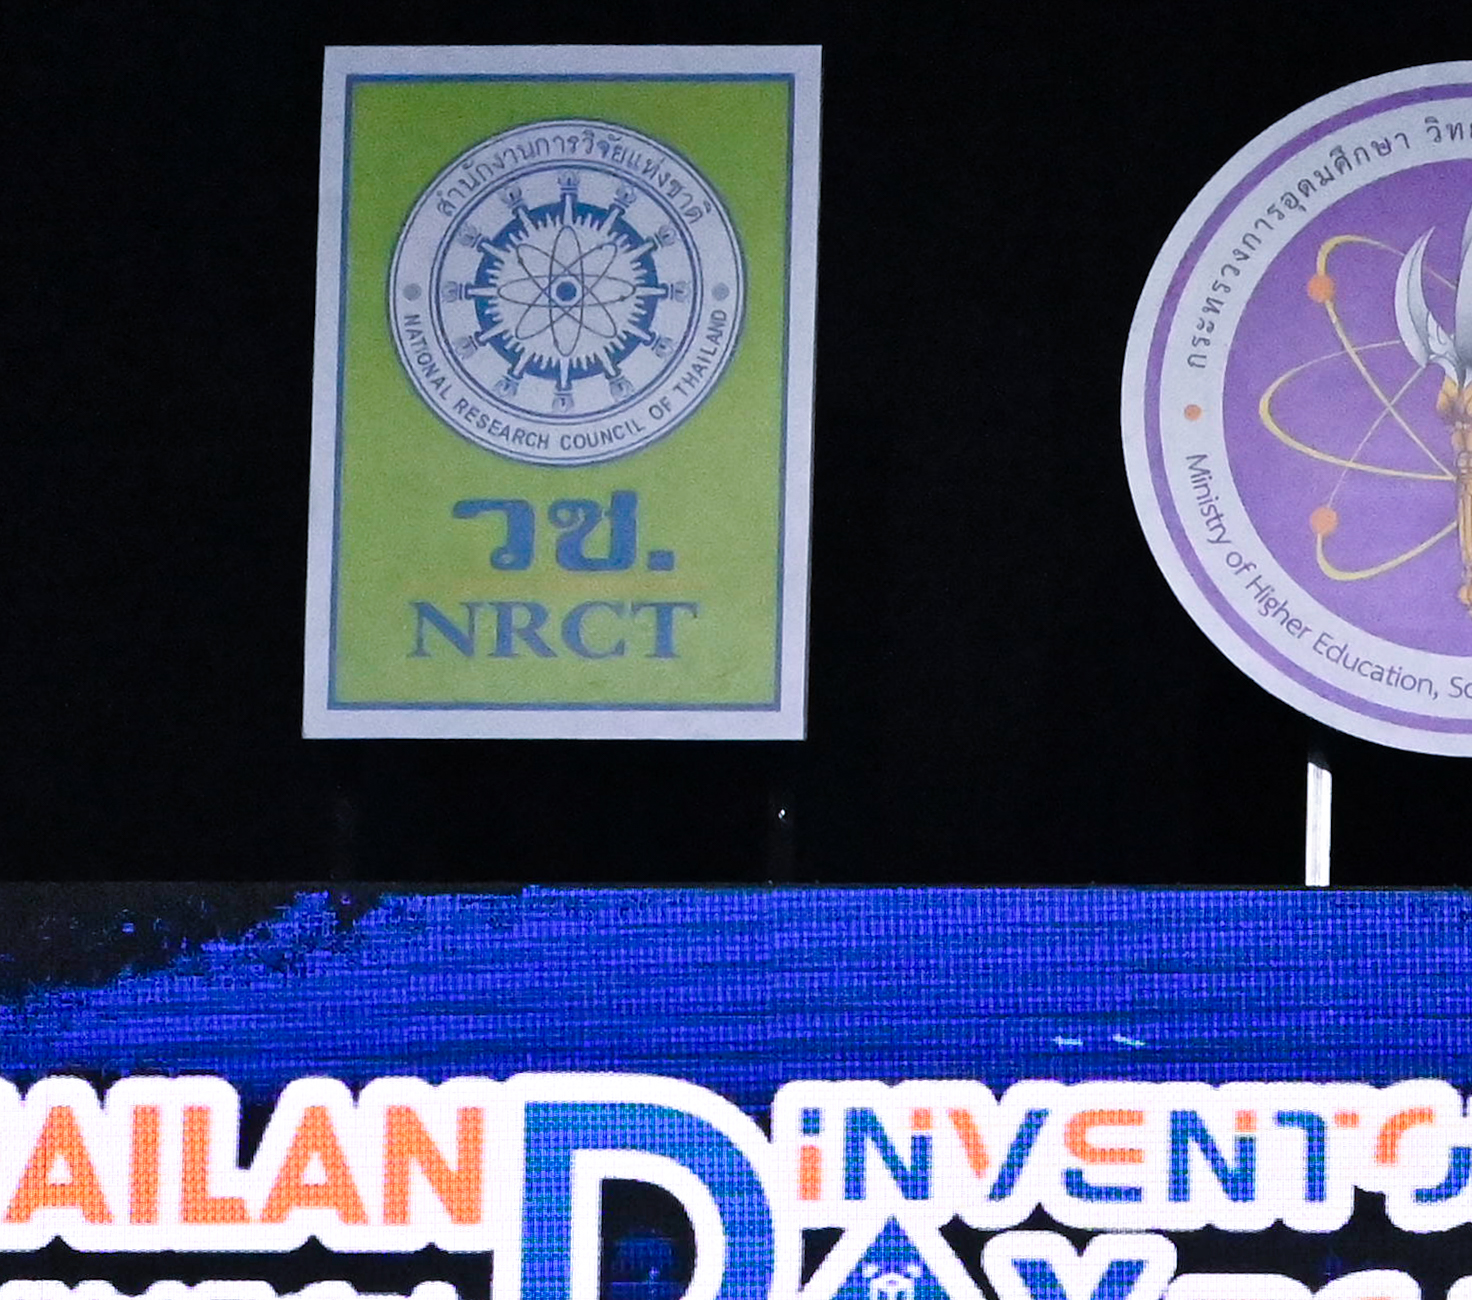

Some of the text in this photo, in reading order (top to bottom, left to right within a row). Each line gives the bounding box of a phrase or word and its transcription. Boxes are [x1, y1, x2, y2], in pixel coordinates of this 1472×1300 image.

[1185, 131, 1409, 370] กระทรวงการอุดมศึกษา
[404, 308, 728, 450] NATIONAL RESEARCH COUNCIL OF THAILAND
[453, 491, 674, 572] วช.
[1184, 452, 1232, 552] Ministry
[1226, 542, 1254, 576] of
[1244, 573, 1312, 641] Higher
[1312, 632, 1440, 701] Education,
[407, 600, 698, 659] NRCT
